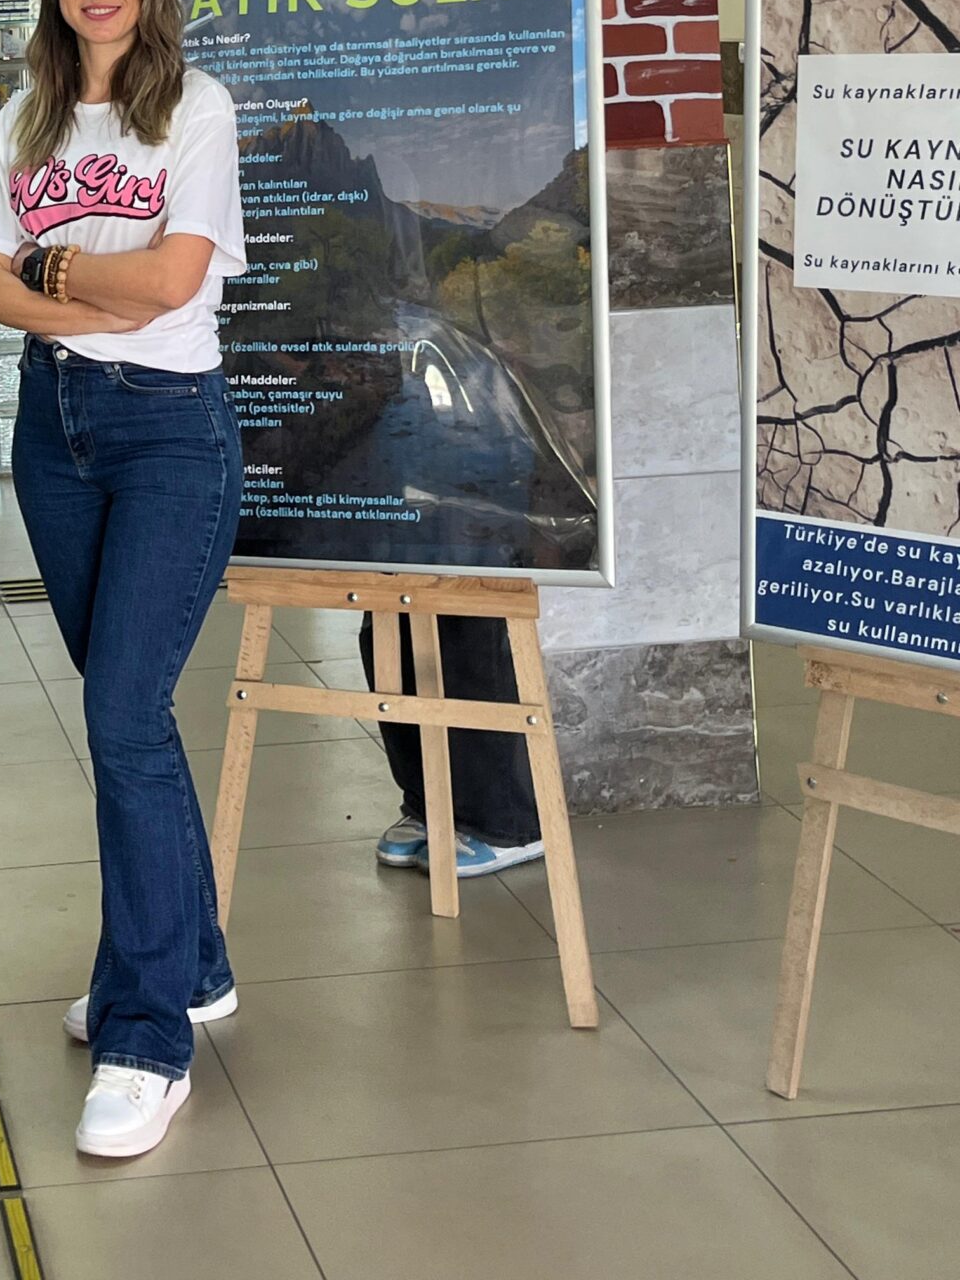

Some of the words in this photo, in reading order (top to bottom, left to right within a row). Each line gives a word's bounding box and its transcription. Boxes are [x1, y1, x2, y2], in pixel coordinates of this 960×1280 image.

[201, 51, 216, 60] su;
[218, 47, 246, 56] evsel,
[250, 43, 311, 55] endüstriyel
[314, 44, 326, 54] ya
[329, 42, 344, 51] da
[346, 39, 392, 50] tarımsal
[394, 36, 451, 48] faaliyetler
[454, 32, 506, 44] sırasında
[509, 29, 565, 40] kullanılan
[202, 36, 213, 45] Su
[216, 33, 250, 43] Nedir?
[227, 59, 274, 69] kirlenmiş
[277, 58, 300, 66] olan
[304, 56, 334, 65] sudur.
[340, 54, 380, 65] Doğaya
[383, 51, 437, 63] doğrudan
[441, 48, 502, 58] bırakılması
[506, 46, 538, 57] çevre
[243, 71, 294, 82] açısından
[297, 68, 357, 79] tehlikelidir.
[360, 67, 374, 76] Bu
[377, 65, 418, 77] yüzden
[421, 62, 474, 73] arıtılması
[476, 59, 519, 72] gerekir.
[813, 84, 834, 100] Su
[266, 97, 308, 110] Oluşur?
[280, 111, 336, 123] kaynağına
[339, 109, 363, 121] göre
[366, 107, 404, 119] değişir
[407, 108, 432, 116] ama
[434, 104, 465, 117] genel
[468, 102, 503, 113] olarak
[507, 104, 520, 114] şu
[840, 138, 874, 158] SU
[74, 154, 168, 213] Girl
[258, 179, 307, 189] kalıntıları
[887, 169, 960, 191] NASI
[263, 193, 300, 203] atıkları
[302, 191, 335, 203] (idrar,
[337, 189, 368, 203] dışkı)
[274, 205, 324, 216] kalıntıları
[816, 192, 960, 227] DÖNÜŞTÜ
[293, 258, 318, 272] gibi)
[804, 254, 824, 268] Su
[830, 256, 939, 274] kaynaklarını
[228, 276, 280, 284] mineraller
[231, 341, 278, 353] (özellikle
[280, 342, 309, 351] evsel
[312, 341, 333, 351] atık
[335, 341, 377, 351] sularda
[240, 374, 296, 385] Maddeler:
[268, 391, 313, 402] çamaşır
[315, 391, 343, 402] suyu
[249, 401, 314, 414] (pestisitler)
[273, 492, 313, 503] solvent
[316, 494, 336, 506] gibi
[338, 494, 404, 507] kimyasallar
[255, 505, 304, 517] (özellikle
[306, 507, 352, 519] hastane
[355, 509, 420, 522] atıklarında)
[784, 524, 888, 555] Türkiye'de
[896, 545, 920, 560] su
[757, 579, 876, 610] geriliyor.Su
[827, 618, 850, 634] su
[858, 620, 960, 654] kullanımı
